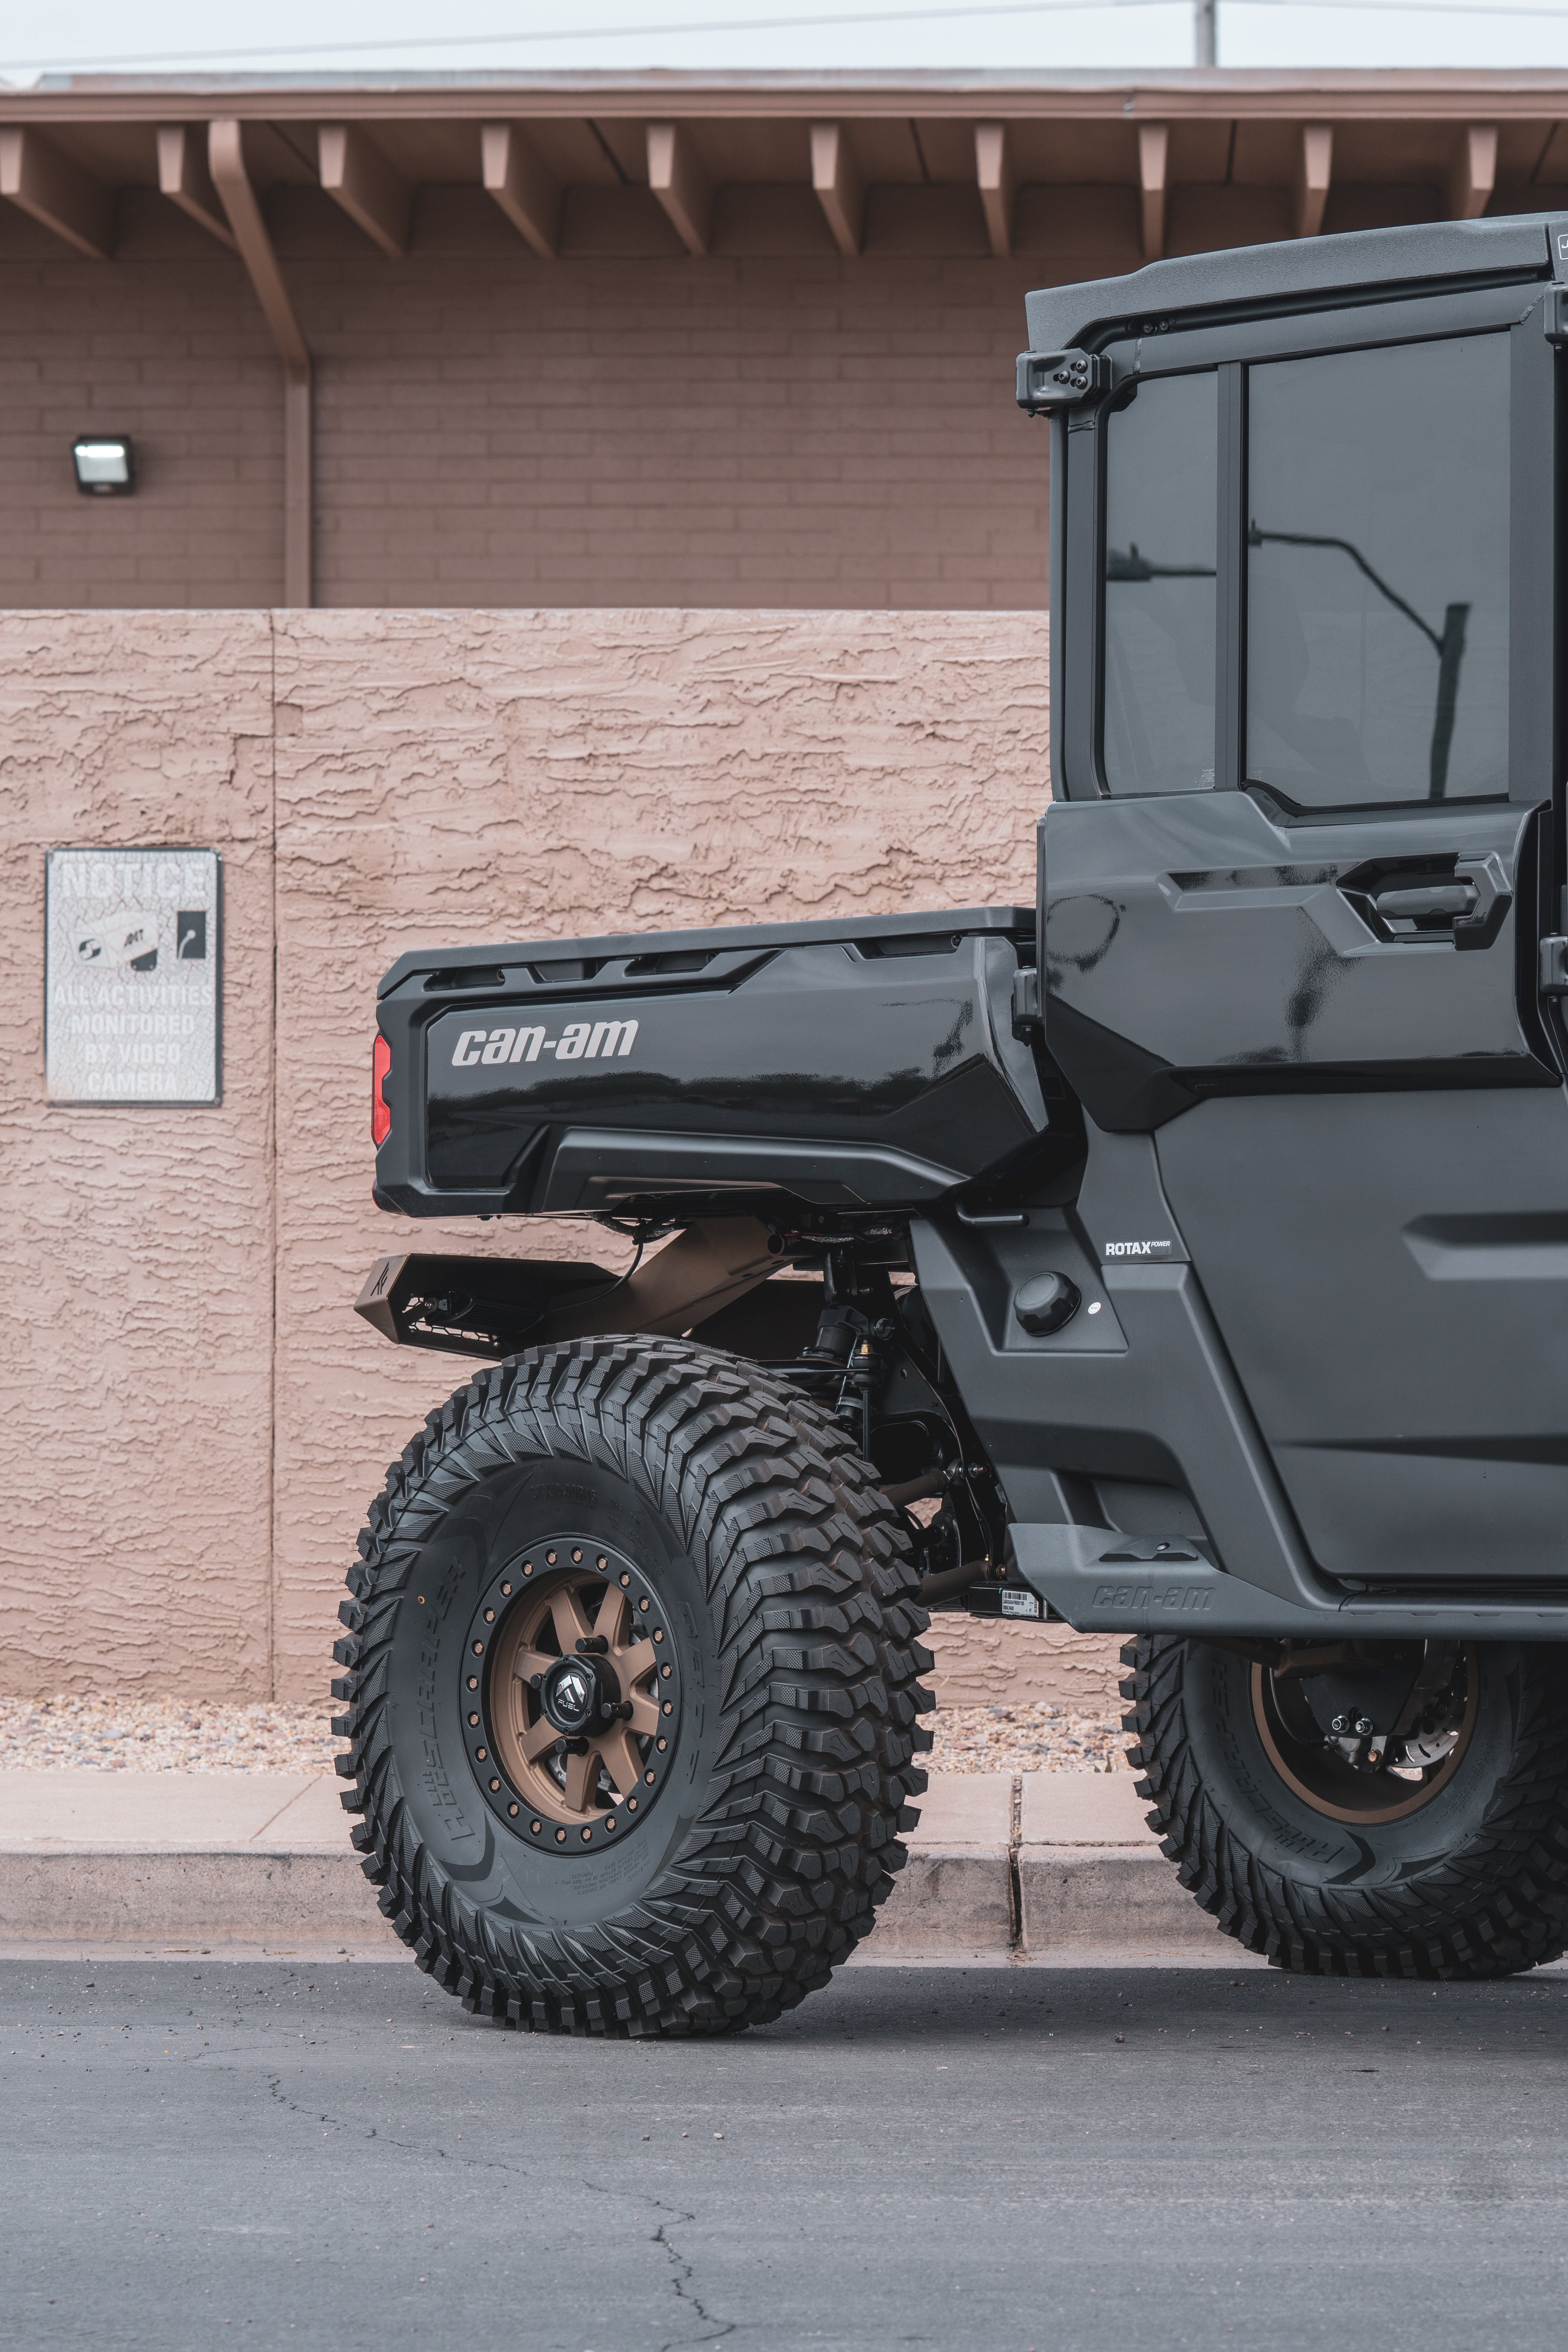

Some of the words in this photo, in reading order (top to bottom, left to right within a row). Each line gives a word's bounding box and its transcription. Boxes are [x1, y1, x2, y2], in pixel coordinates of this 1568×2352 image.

[62, 862, 206, 898] NOTICE
[54, 986, 95, 1005] ALL
[98, 985, 212, 1006] ACTIVITIES
[71, 1014, 195, 1035] MONITORED
[85, 1044, 110, 1063] BY
[118, 1044, 180, 1063] VIDEO
[451, 1019, 639, 1067] can-am
[87, 1073, 178, 1093] CAMERA
[1105, 1241, 1151, 1256] ROTAX
[1092, 1586, 1216, 1610] can-am
[558, 1699, 580, 1712] FUEL
